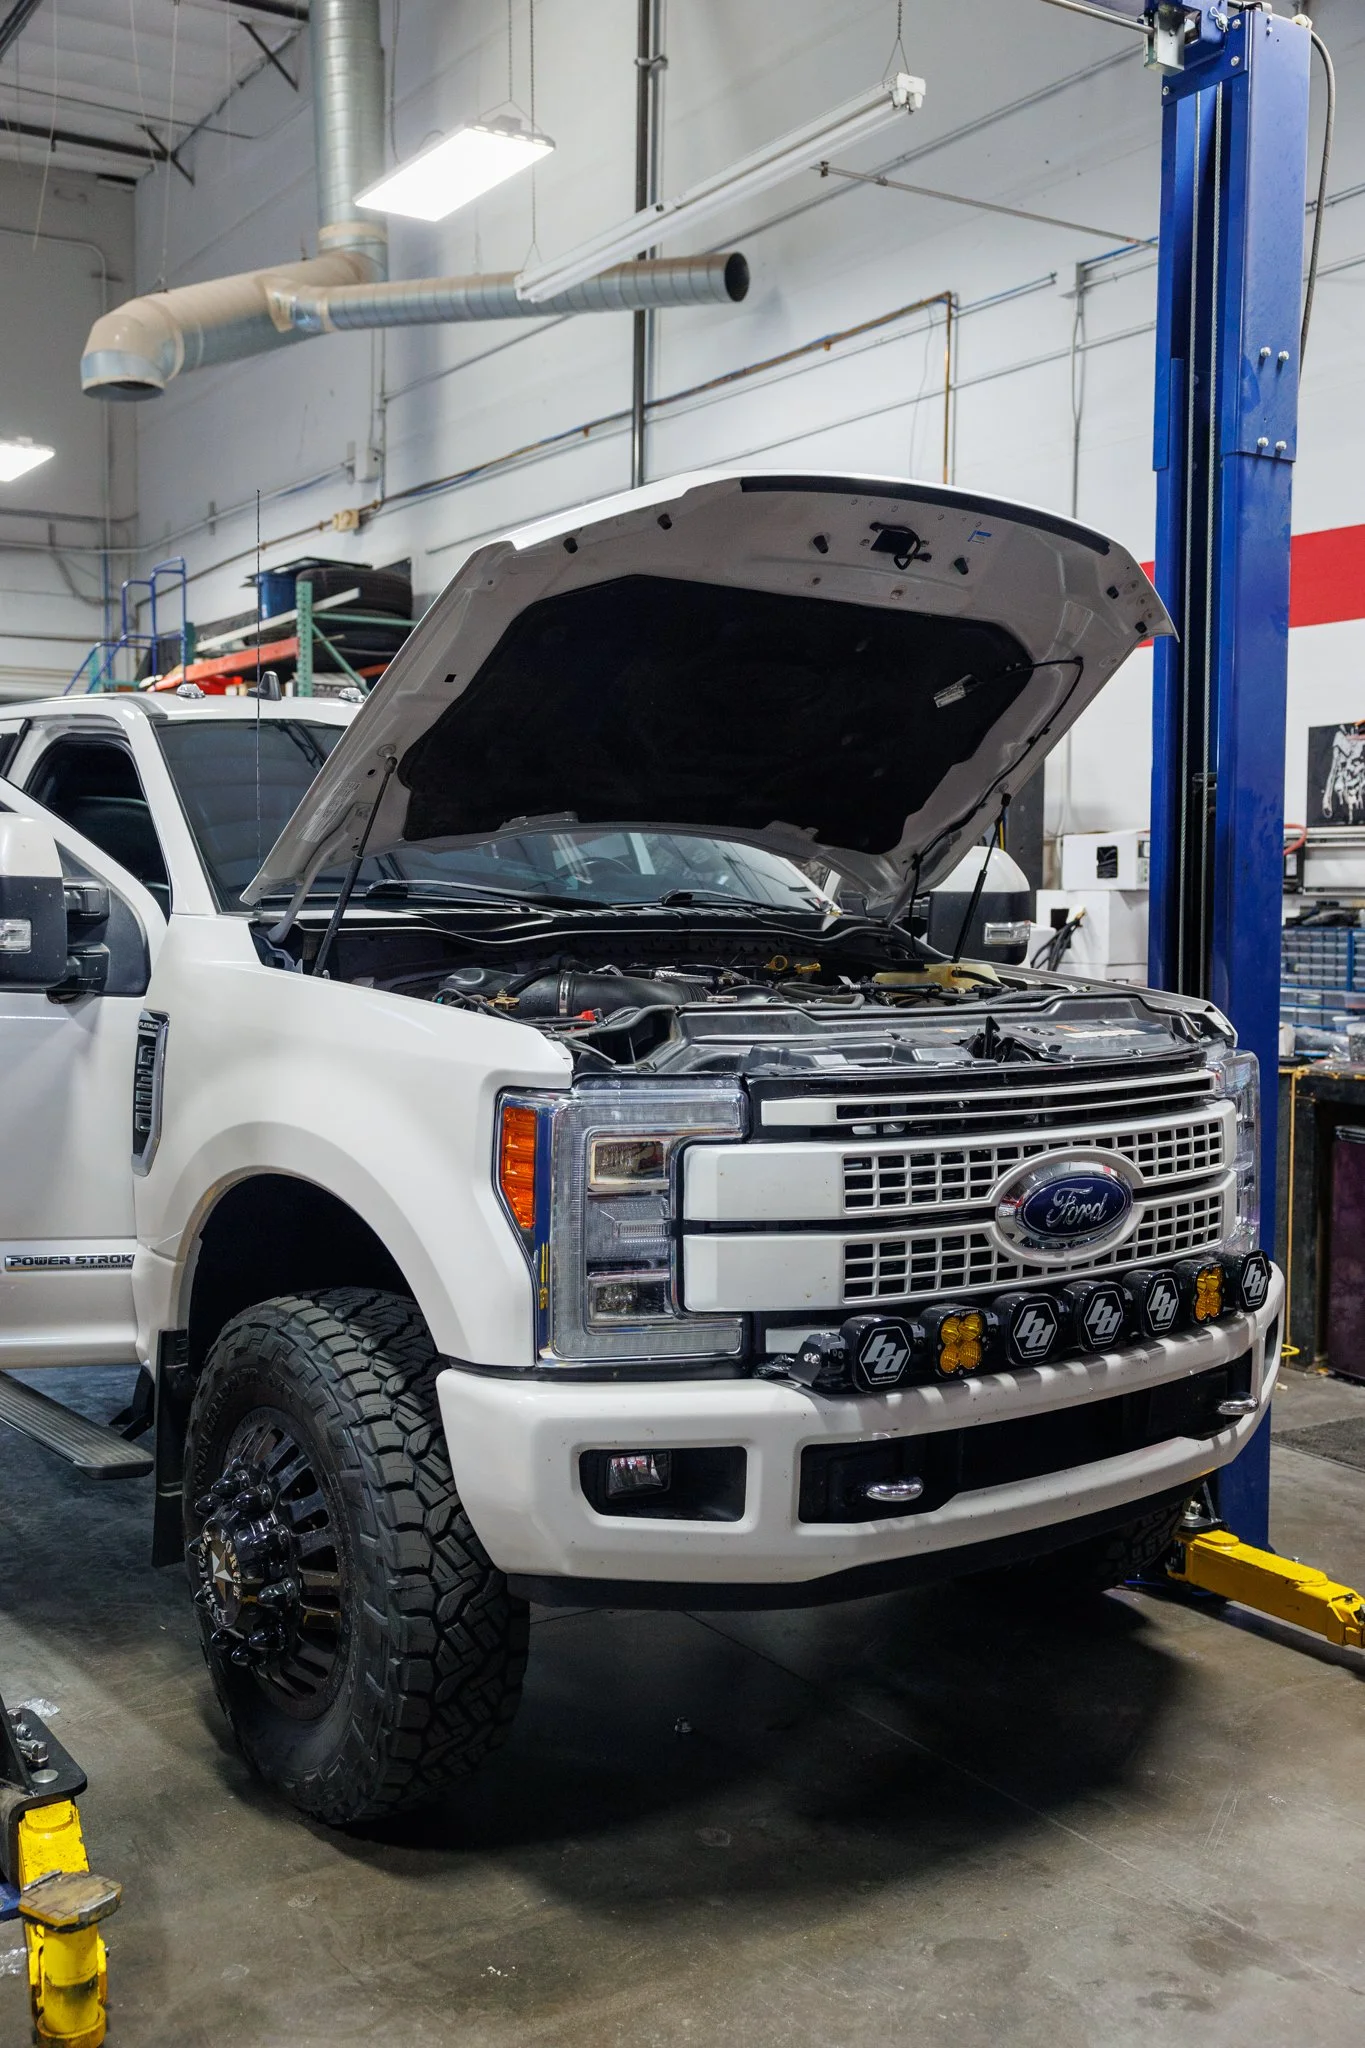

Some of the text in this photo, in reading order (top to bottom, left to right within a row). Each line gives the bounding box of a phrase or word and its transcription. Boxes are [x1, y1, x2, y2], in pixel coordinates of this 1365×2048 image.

[1046, 1186, 1107, 1227] Ford
[10, 1256, 71, 1266] POWER
[1087, 1298, 1121, 1335] bd
[1149, 1285, 1177, 1321] bd
[1016, 1310, 1055, 1348] bd
[863, 1334, 908, 1374] bd
